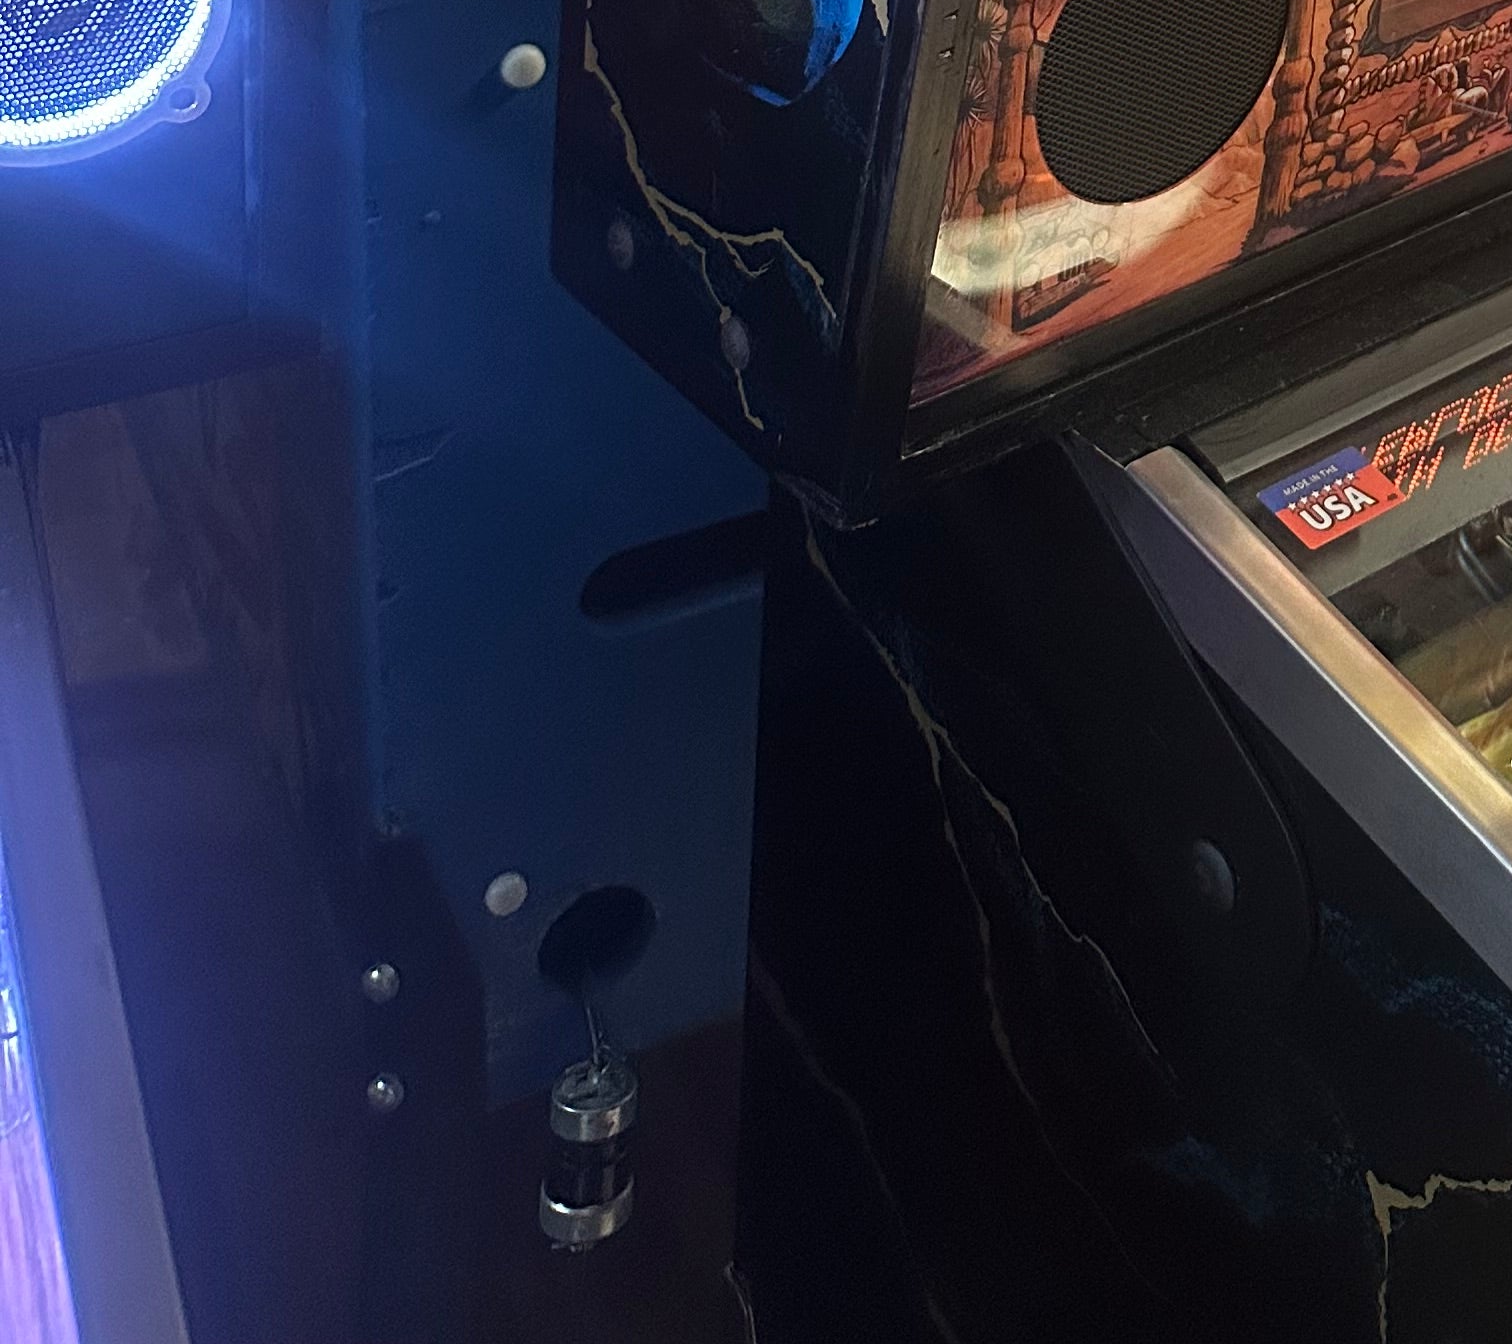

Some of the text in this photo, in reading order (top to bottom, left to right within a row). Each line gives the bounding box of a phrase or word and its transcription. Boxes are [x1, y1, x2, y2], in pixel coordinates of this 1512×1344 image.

[1282, 477, 1311, 496] MADE
[1320, 463, 1339, 478] THE
[1299, 485, 1377, 531] USA
